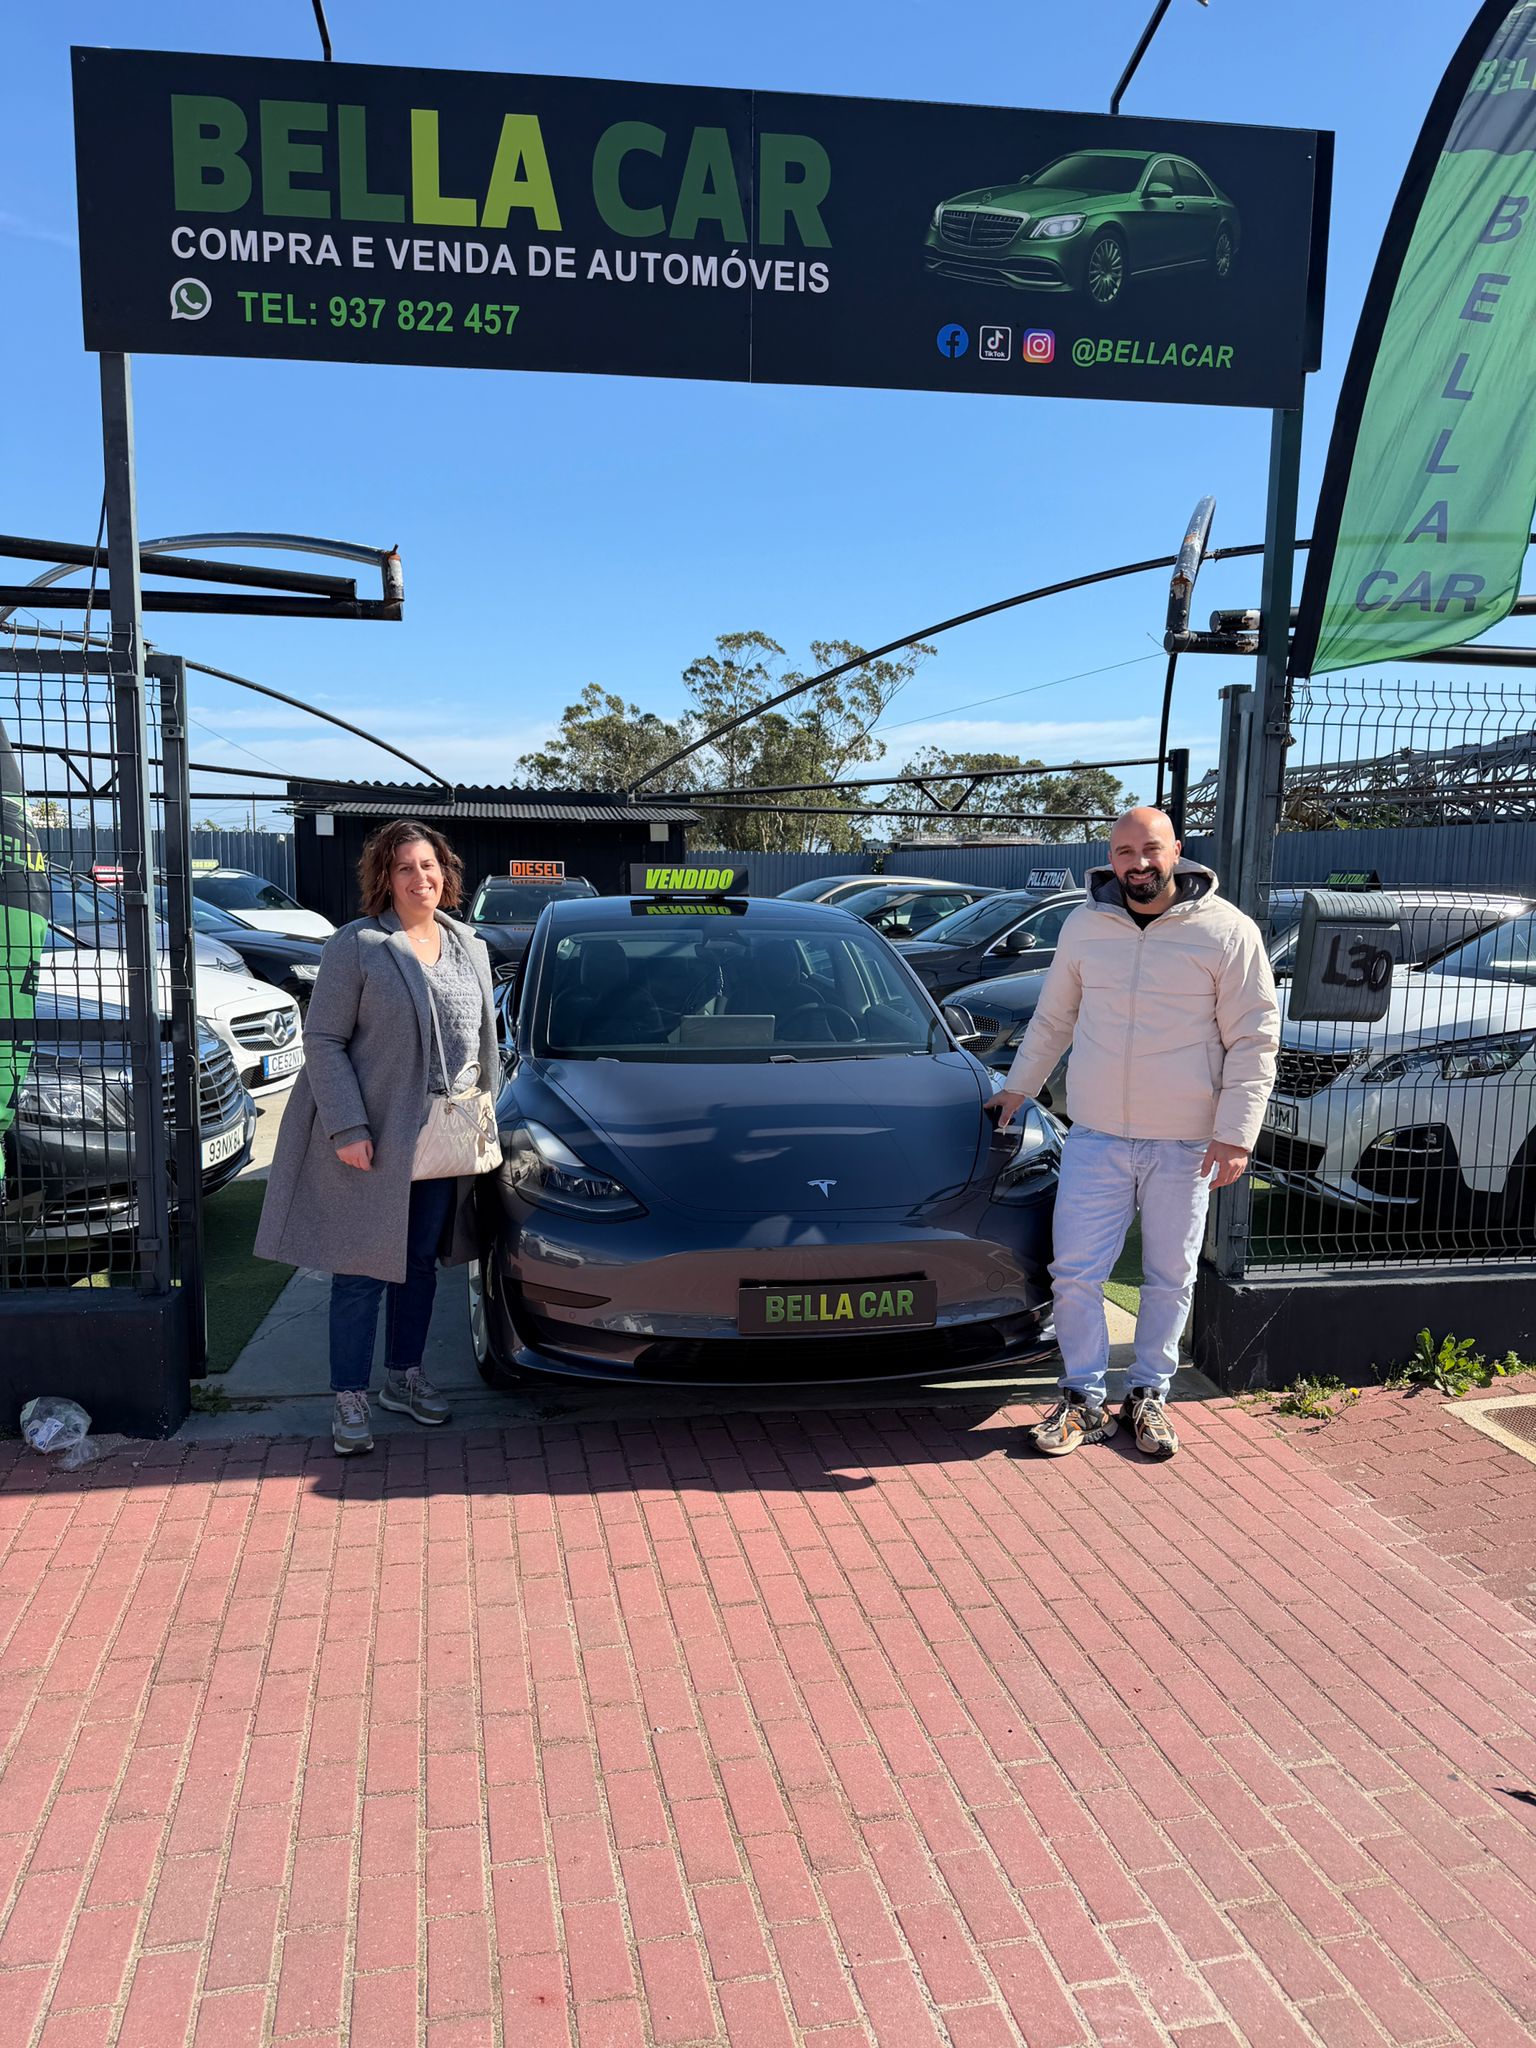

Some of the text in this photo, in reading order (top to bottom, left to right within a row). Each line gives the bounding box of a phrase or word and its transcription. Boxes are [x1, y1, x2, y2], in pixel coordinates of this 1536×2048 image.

[1468, 58, 1536, 95] BEL
[171, 94, 832, 248] BELLA CAR
[171, 227, 830, 293] COMPRA E VENDA DE AUTOMÓVEIS
[238, 291, 520, 335] TEL: 937 822 457
[984, 350, 1006, 358] TikTok
[1072, 338, 1234, 369] @BELLACAR
[1406, 195, 1529, 543] BELLA
[1356, 570, 1486, 613] CAR
[511, 862, 562, 877] DIESEL
[645, 868, 735, 890] VENDIDO
[1321, 934, 1392, 992] L30
[765, 1290, 914, 1324] BELLA CAR
